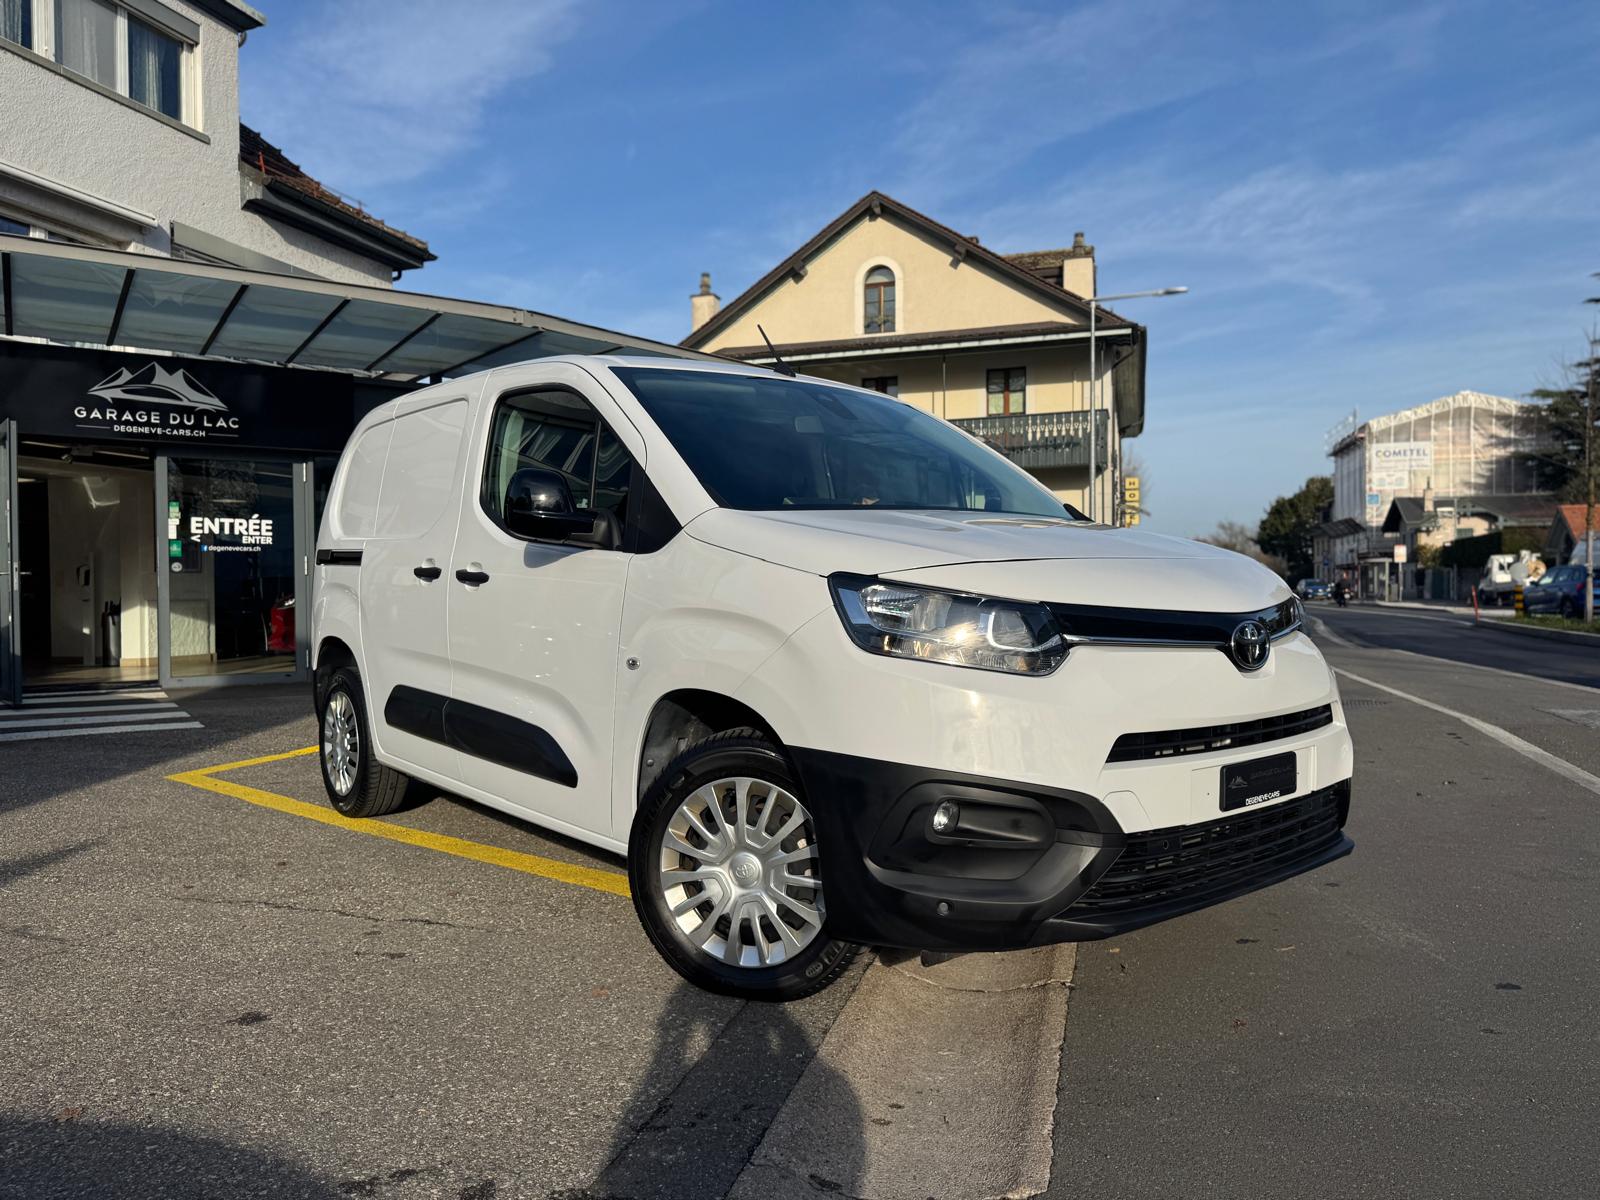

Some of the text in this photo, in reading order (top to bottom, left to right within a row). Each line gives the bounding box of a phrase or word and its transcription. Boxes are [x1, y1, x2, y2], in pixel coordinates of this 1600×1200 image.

[74, 406, 239, 428] GARAGE DU LAC
[113, 425, 206, 437] DEGENEVE-CARS.CH
[1375, 448, 1428, 458] COMETEL
[190, 513, 273, 536] ENTRÉE
[242, 535, 273, 545] ENTER
